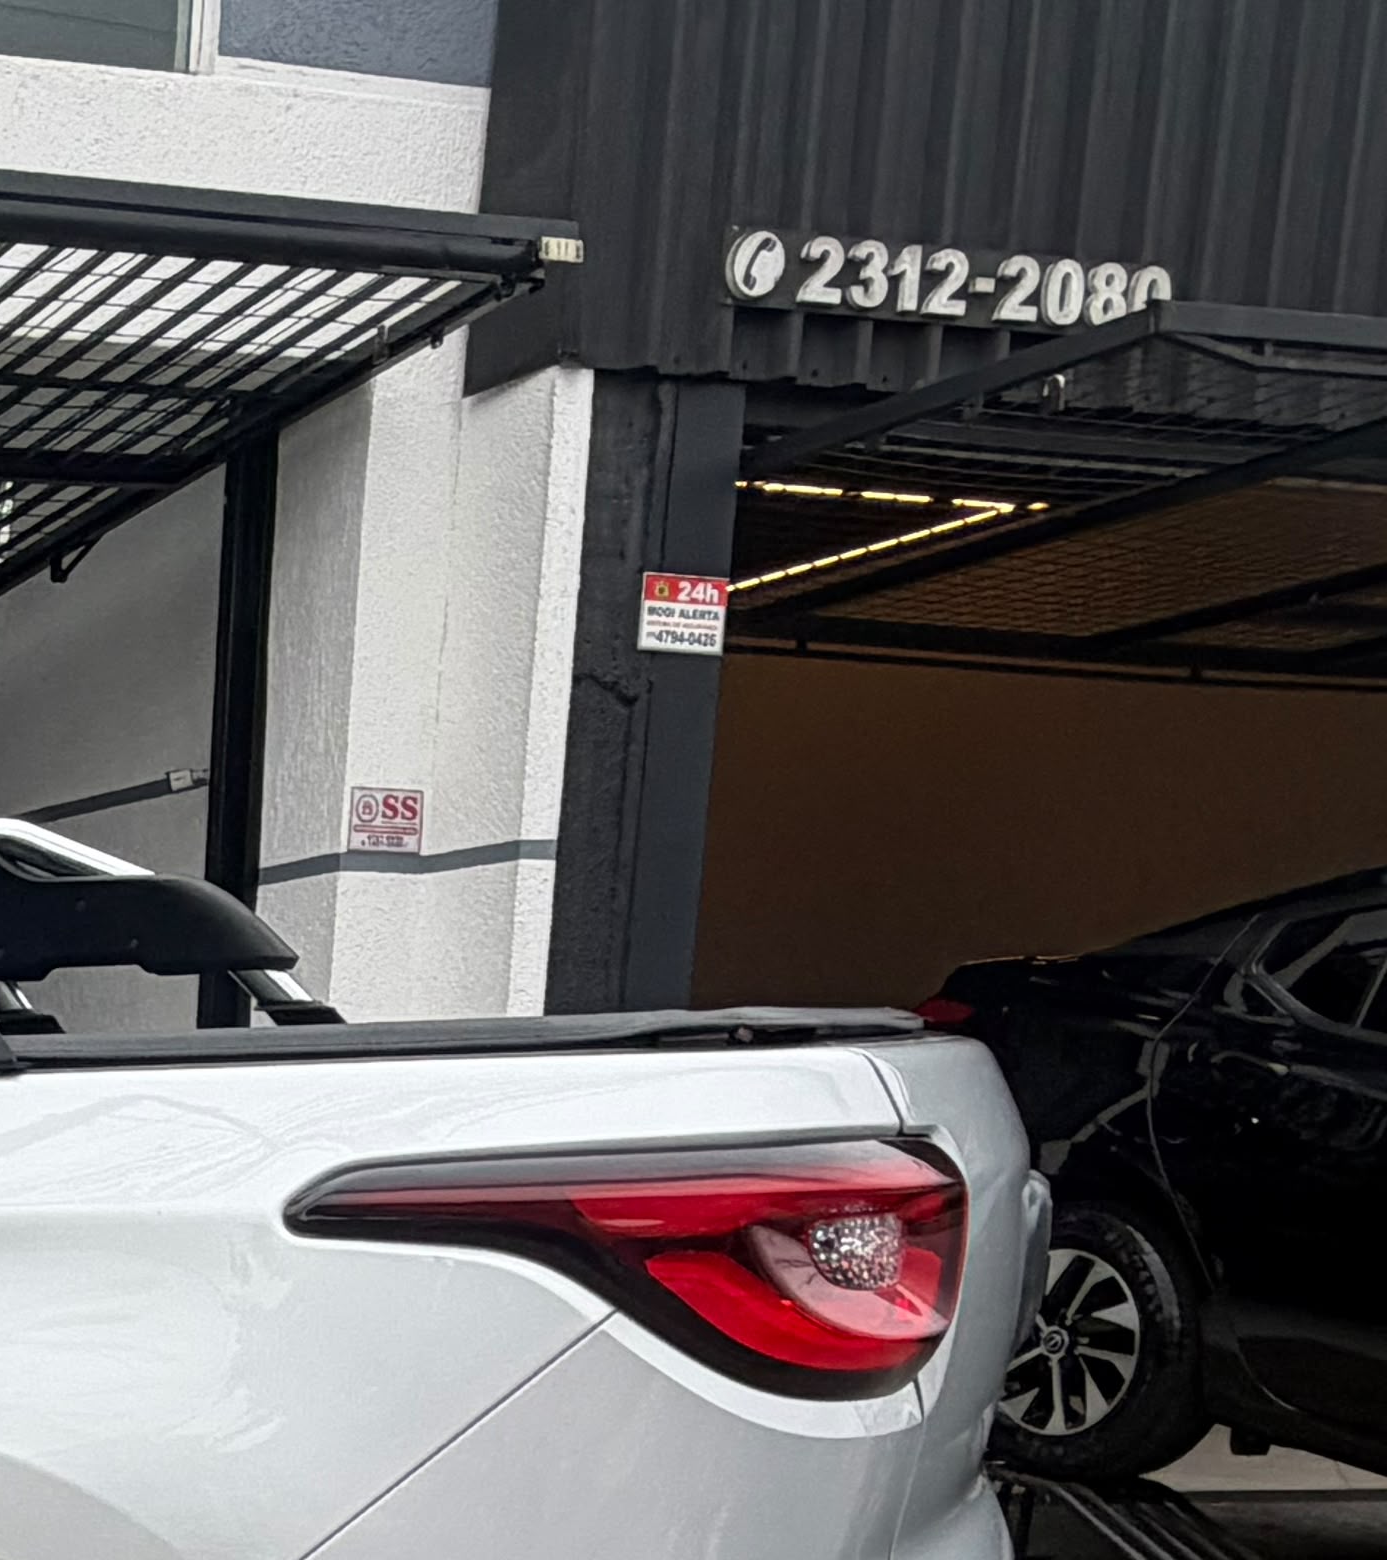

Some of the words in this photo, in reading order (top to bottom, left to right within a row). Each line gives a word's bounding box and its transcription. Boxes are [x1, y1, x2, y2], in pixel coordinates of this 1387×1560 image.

[677, 580, 719, 604] 24h
[678, 608, 720, 621] ALERTA
[381, 794, 418, 821] SS
